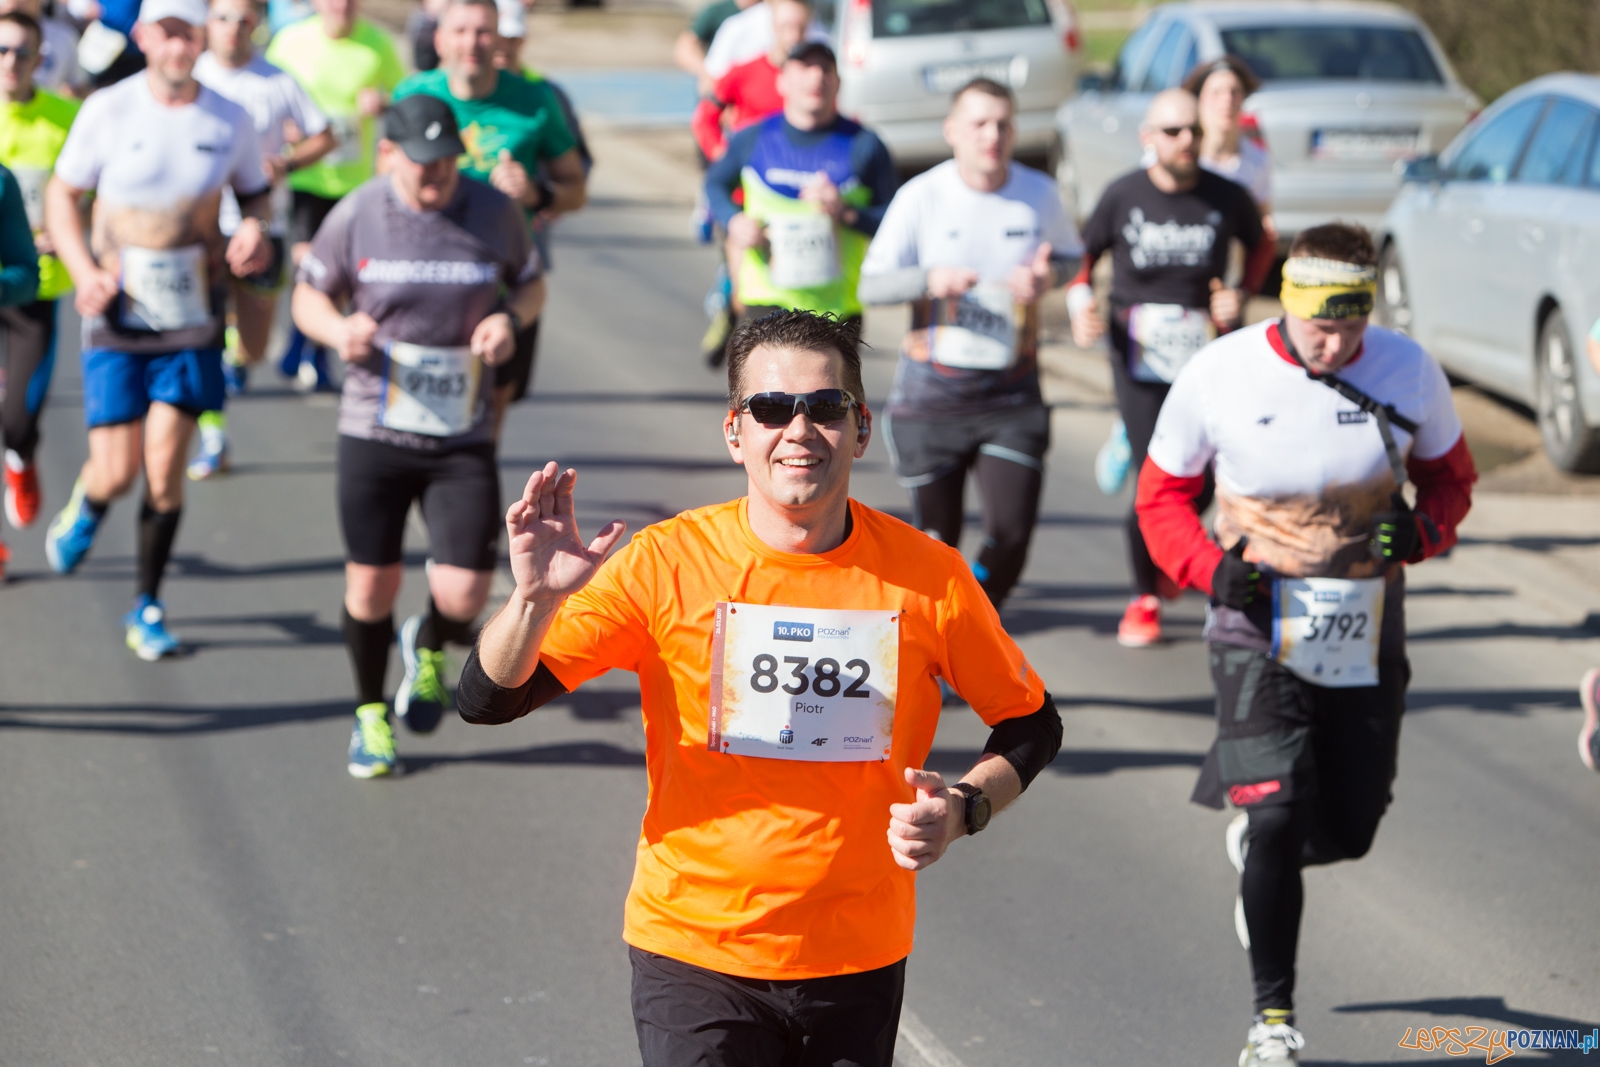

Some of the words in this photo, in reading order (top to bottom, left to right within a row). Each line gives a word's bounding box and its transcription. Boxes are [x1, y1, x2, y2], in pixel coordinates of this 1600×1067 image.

[791, 628, 811, 637] PKO
[1303, 612, 1368, 641] 3792
[750, 653, 871, 698] 8382
[795, 702, 825, 714] Piotr
[811, 737, 828, 746] 4F
